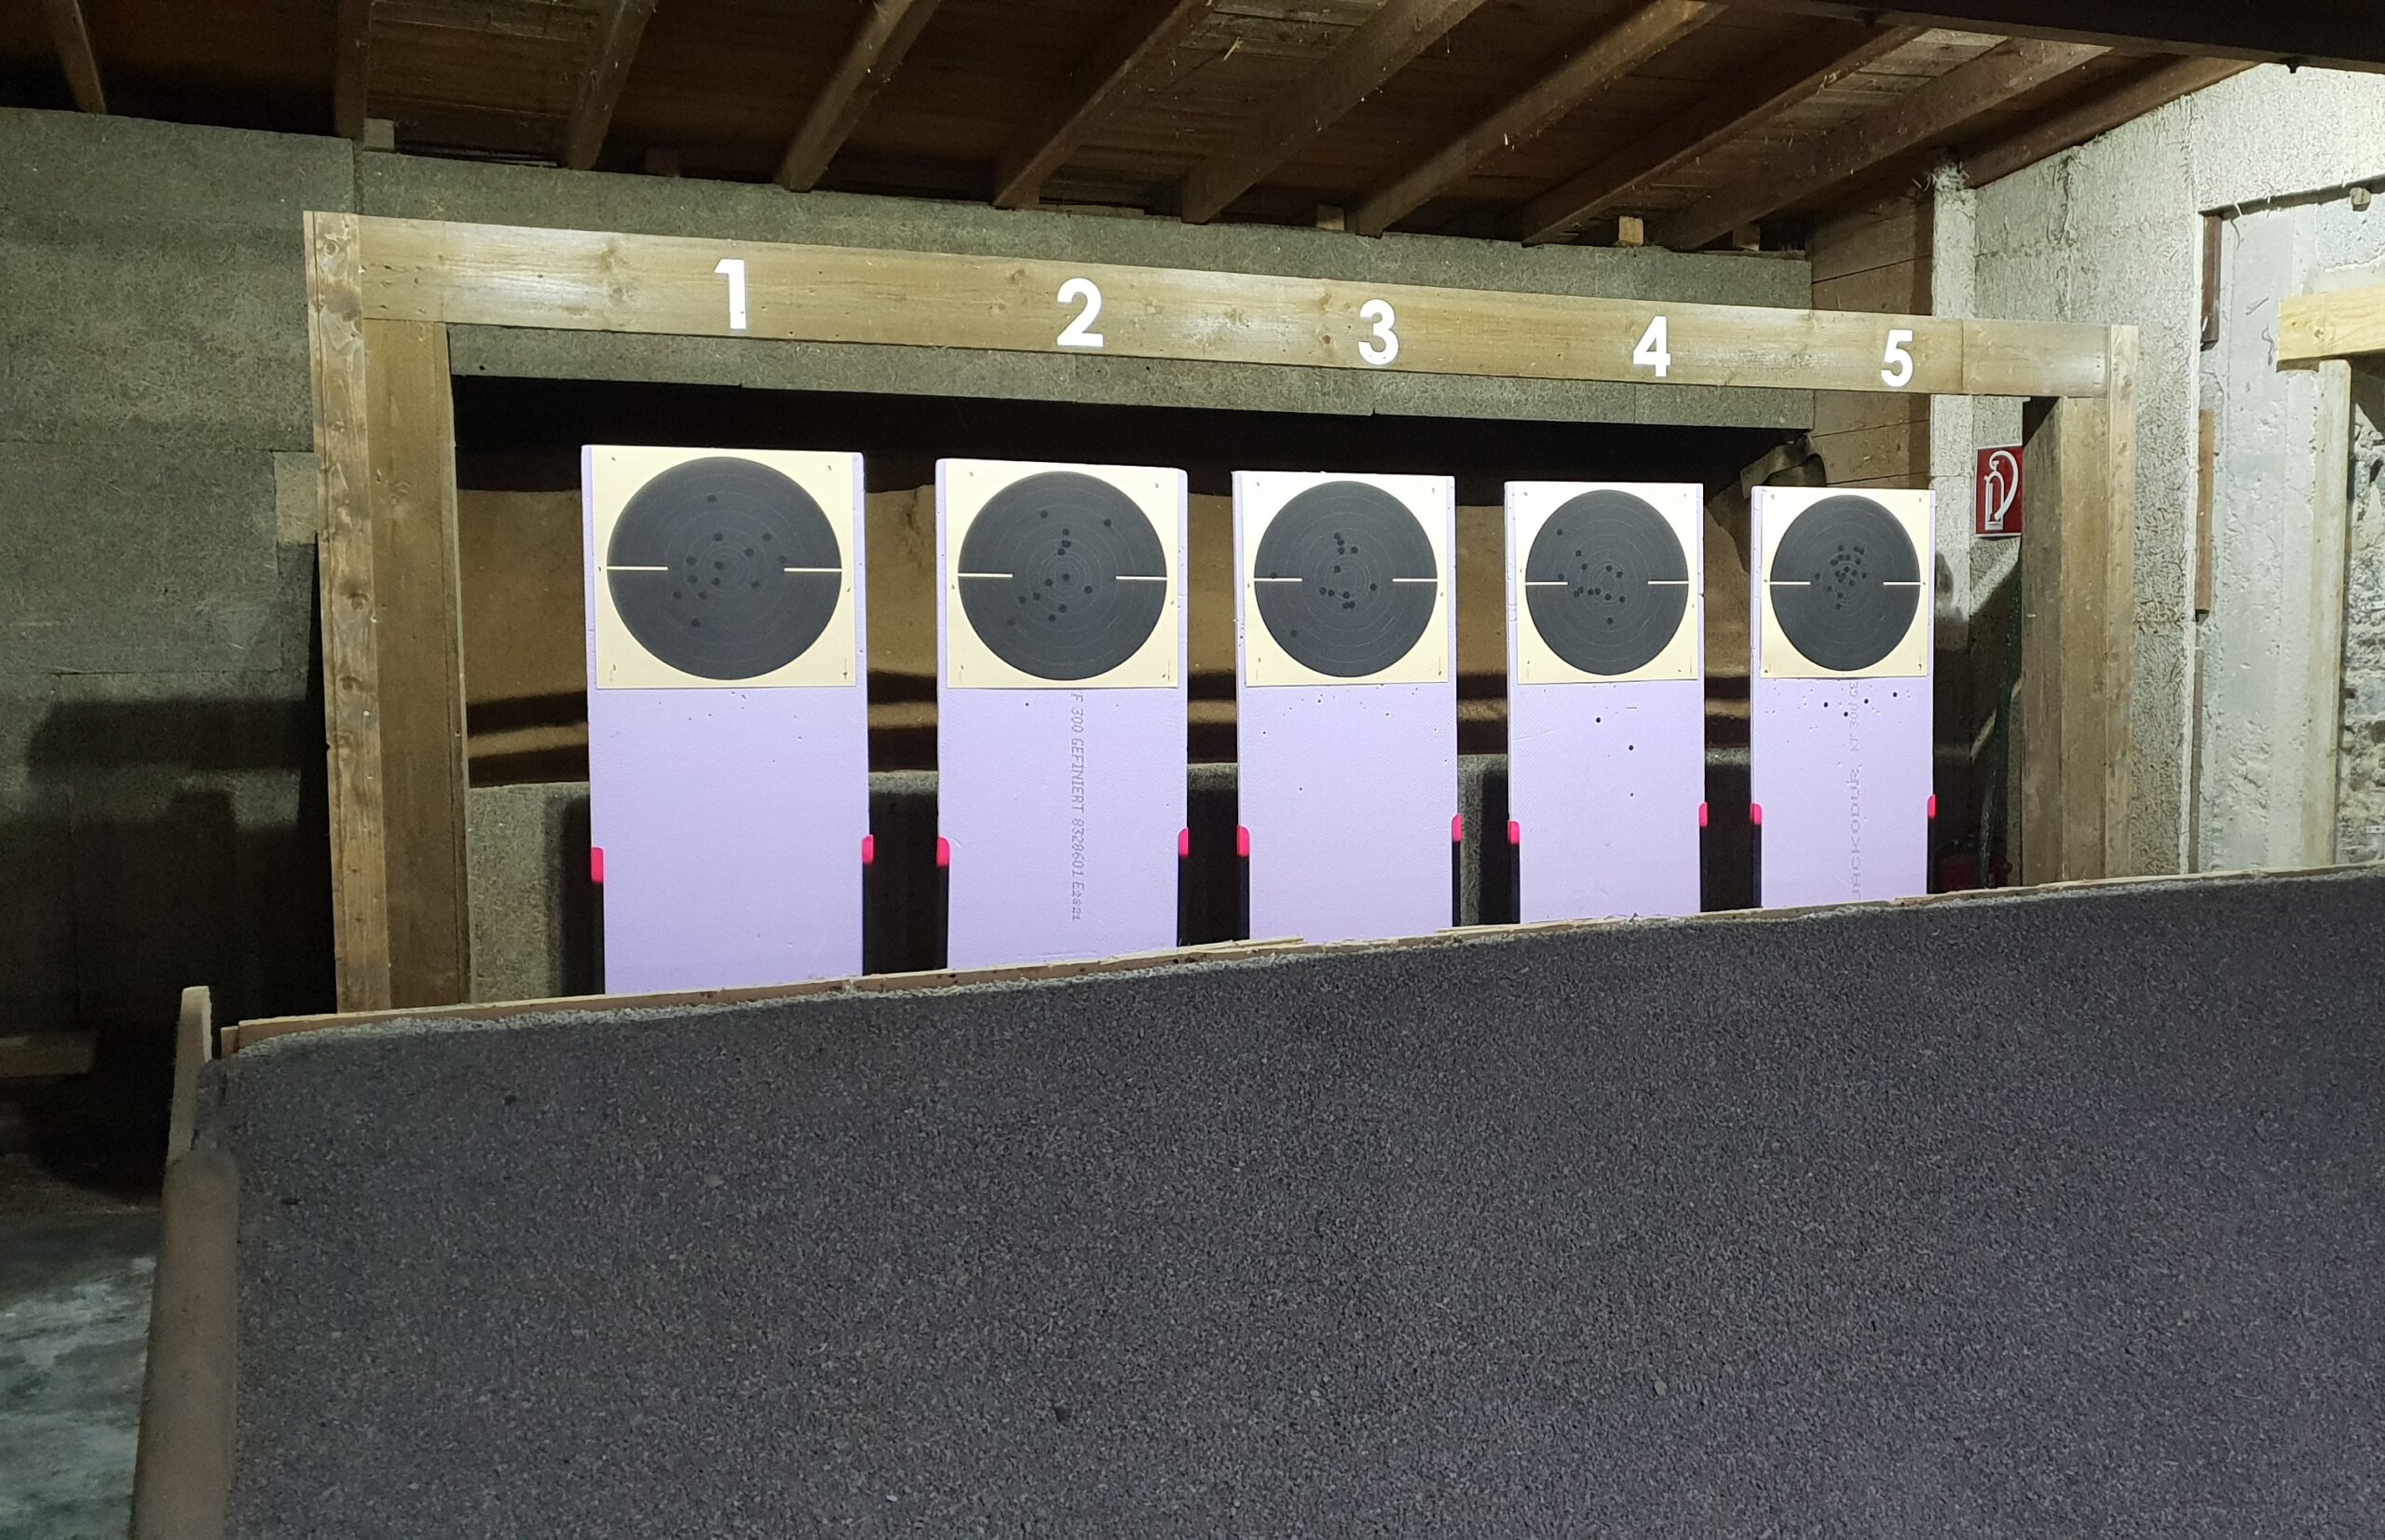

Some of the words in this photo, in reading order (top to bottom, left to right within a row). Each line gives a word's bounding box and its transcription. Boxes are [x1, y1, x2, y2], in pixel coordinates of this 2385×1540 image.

[714, 258, 746, 330] 1
[1056, 278, 1104, 348] 2
[1357, 298, 1399, 366] 3
[1632, 315, 1671, 377] 4
[1880, 329, 1915, 388] 5
[1070, 708, 1084, 734] 300
